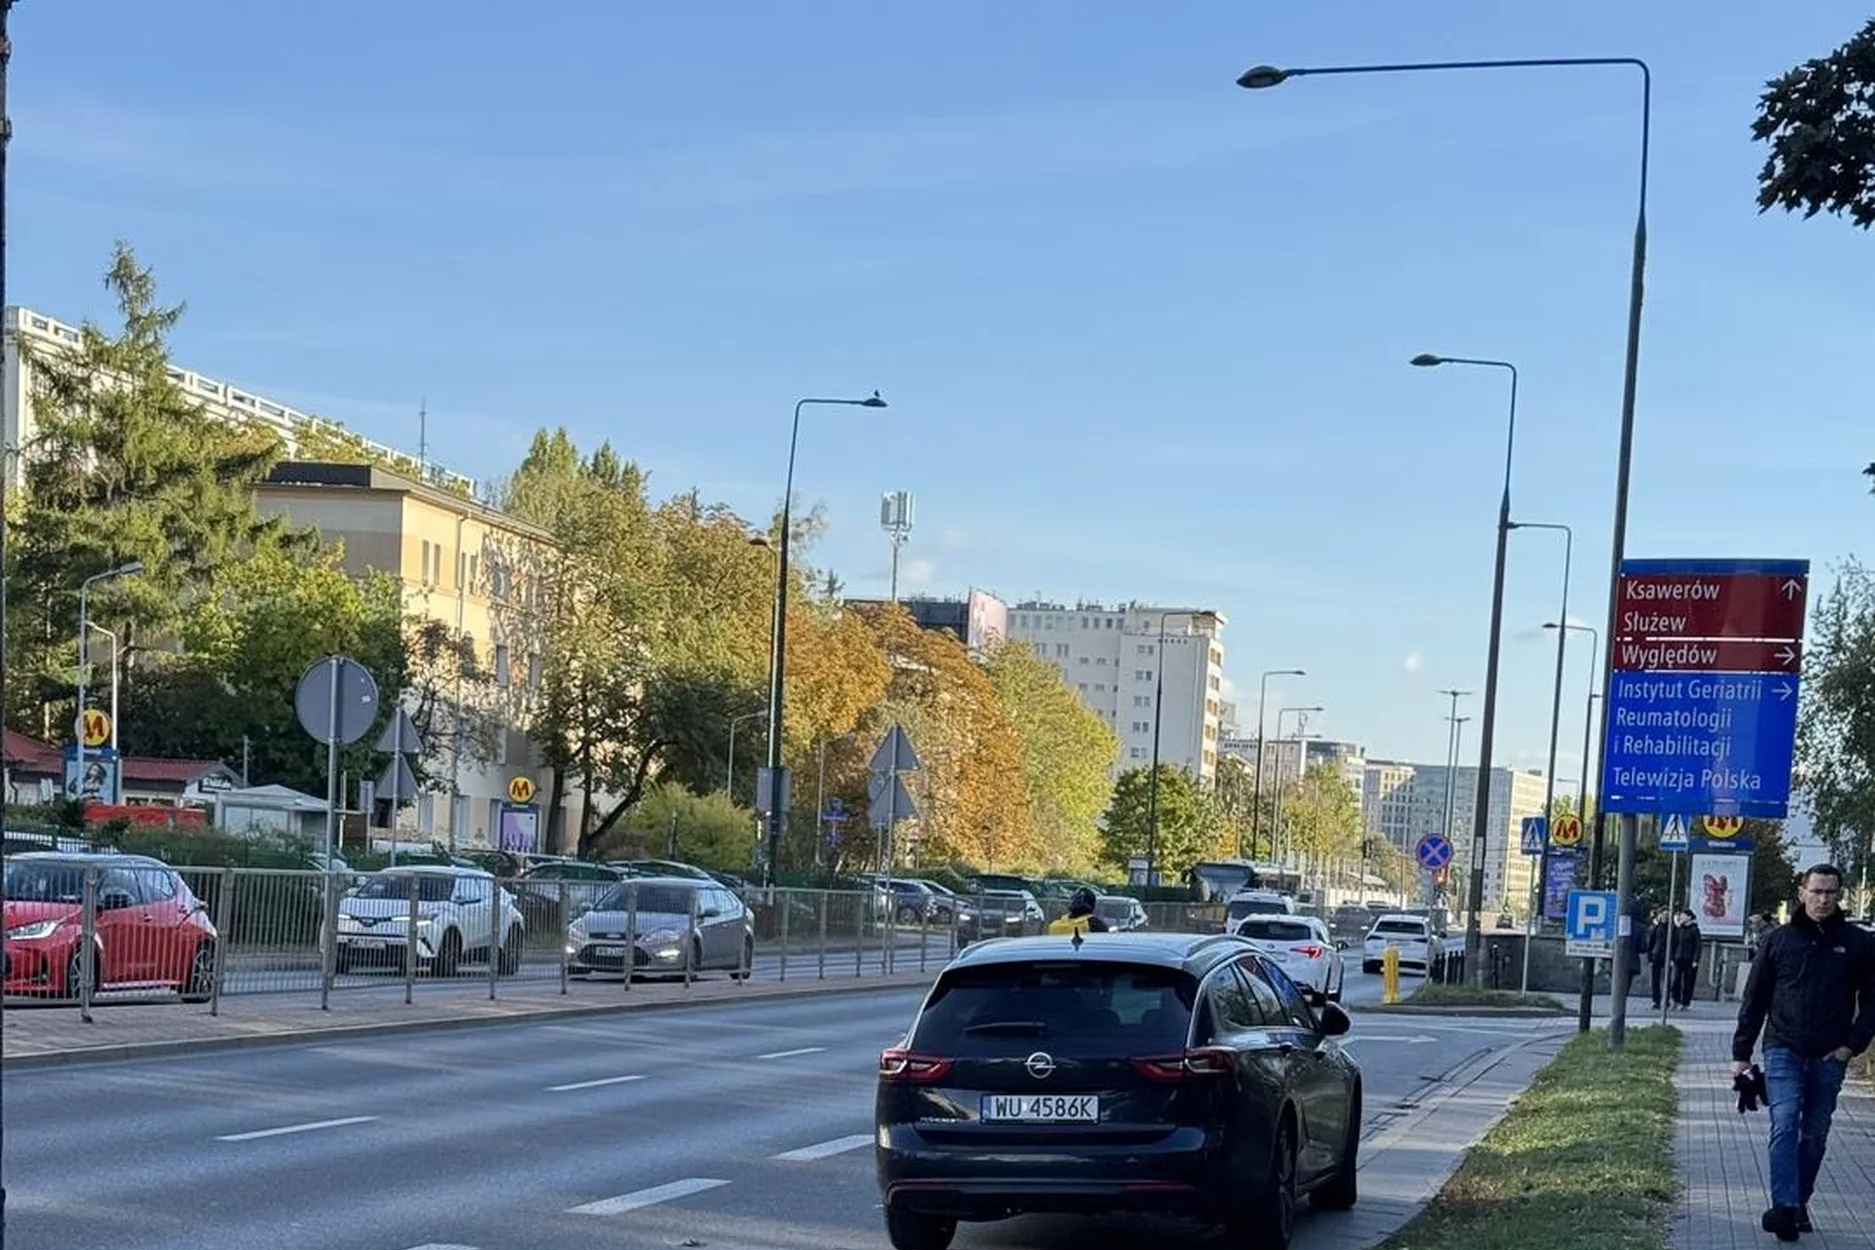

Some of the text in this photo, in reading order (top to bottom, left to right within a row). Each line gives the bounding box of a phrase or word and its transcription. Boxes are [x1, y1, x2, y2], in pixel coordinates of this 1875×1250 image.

[1626, 580, 1720, 600] Ksawerów
[1623, 612, 1687, 632] Służew
[1622, 644, 1718, 670] Wyględów
[1618, 680, 1763, 703] Instytut Geriatrii
[1616, 707, 1732, 733] Reumatologii
[1614, 734, 1731, 760] i Rehabilitacji
[1613, 766, 1762, 792] Telewizja Polska
[1576, 896, 1607, 935] P
[996, 1097, 1093, 1118] WU 4586K
